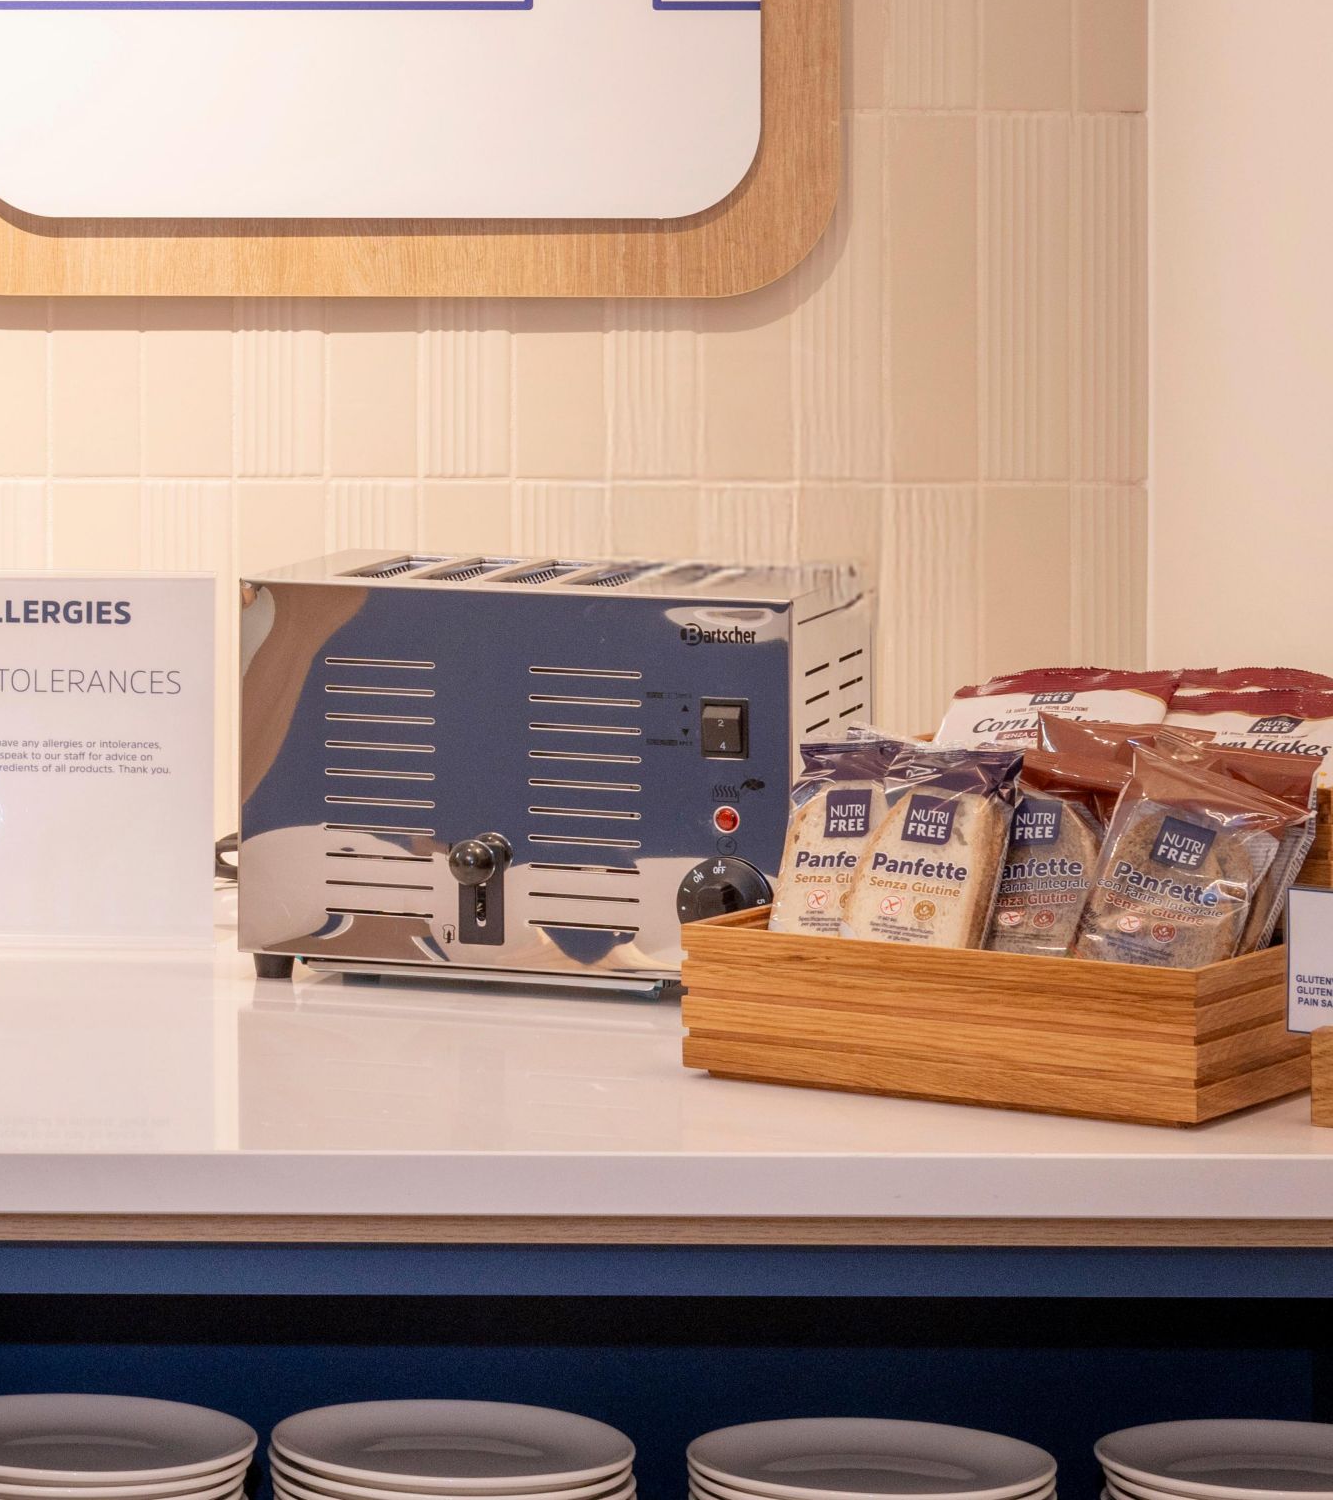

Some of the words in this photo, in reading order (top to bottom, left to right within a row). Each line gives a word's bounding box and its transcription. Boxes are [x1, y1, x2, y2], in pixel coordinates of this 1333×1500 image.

[680, 623, 756, 646] Bartscher
[717, 719, 724, 727] 2
[972, 717, 1031, 734] Corn
[1257, 720, 1295, 728] NUTRI
[1002, 731, 1029, 739] SENZA
[22, 740, 39, 748] any
[42, 739, 83, 749] allergies
[99, 740, 161, 749] intolerances,
[719, 741, 726, 750] 4
[0, 751, 28, 760] speak
[31, 752, 41, 760] to
[63, 752, 85, 760] staff
[88, 752, 102, 760] for
[105, 752, 137, 761] advice
[42, 764, 52, 772] of
[54, 764, 66, 772] all
[69, 765, 114, 773] products.
[118, 765, 148, 773] Thank
[830, 804, 866, 818] NUTRI
[910, 809, 950, 824] NUTRI
[829, 818, 865, 832] FREE
[1015, 813, 1056, 826] NUTRI
[907, 822, 947, 839] FREE
[1015, 826, 1054, 840] FREE
[1162, 831, 1206, 855] NUTRI
[795, 851, 859, 868] Panfe
[1156, 844, 1201, 866] FREE
[712, 866, 726, 874] OFF
[871, 852, 968, 881] Panfette
[1002, 858, 1083, 880] anfette
[693, 872, 705, 883] ON
[794, 873, 831, 884] Senza
[1037, 878, 1091, 891] Integrale
[1113, 861, 1219, 908] Panfette
[869, 876, 907, 891] Senza
[911, 883, 961, 898] Glutine
[1027, 893, 1077, 905] Glutine
[1097, 878, 1123, 893] con
[1123, 885, 1163, 906] Farina
[1165, 900, 1224, 918] Integrale
[1105, 892, 1146, 914] Senza
[1150, 908, 1205, 926] Glutine
[1297, 997, 1319, 1006] PAIN
[1321, 999, 1333, 1008] SA
